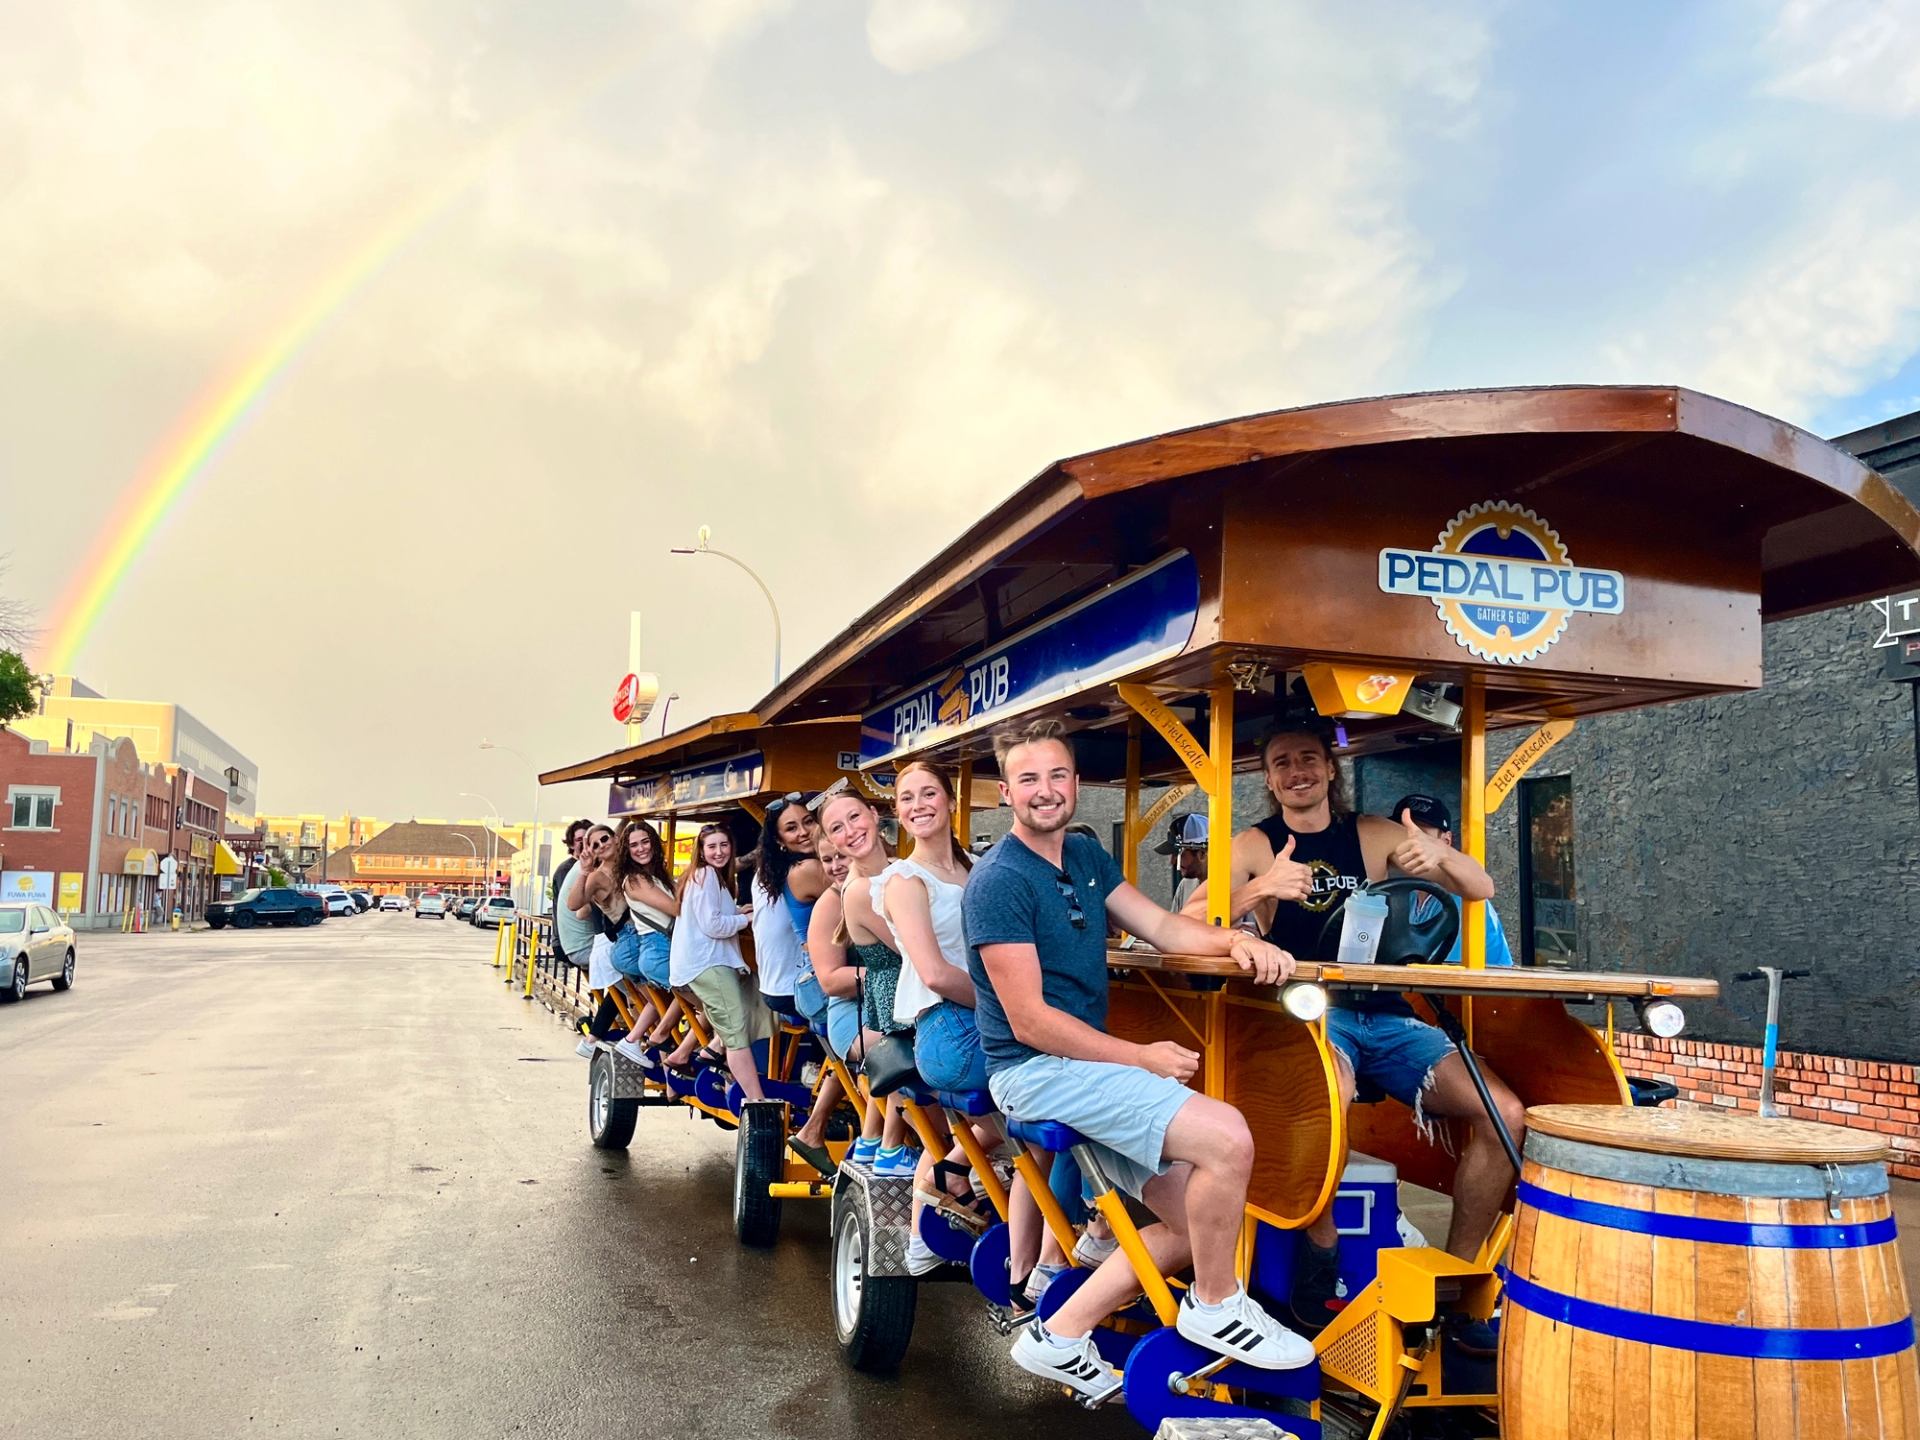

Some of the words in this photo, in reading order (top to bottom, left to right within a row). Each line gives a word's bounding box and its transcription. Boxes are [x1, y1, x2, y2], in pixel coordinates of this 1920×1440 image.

[1386, 552, 1524, 600] PEDAL
[1531, 567, 1619, 609] PUB
[1477, 607, 1506, 622] GATHER
[1508, 610, 1514, 624] &
[893, 691, 938, 746] PEDAL
[969, 656, 1009, 716] PUB
[1493, 769, 1515, 793] Het
[1326, 875, 1357, 890] PUB
